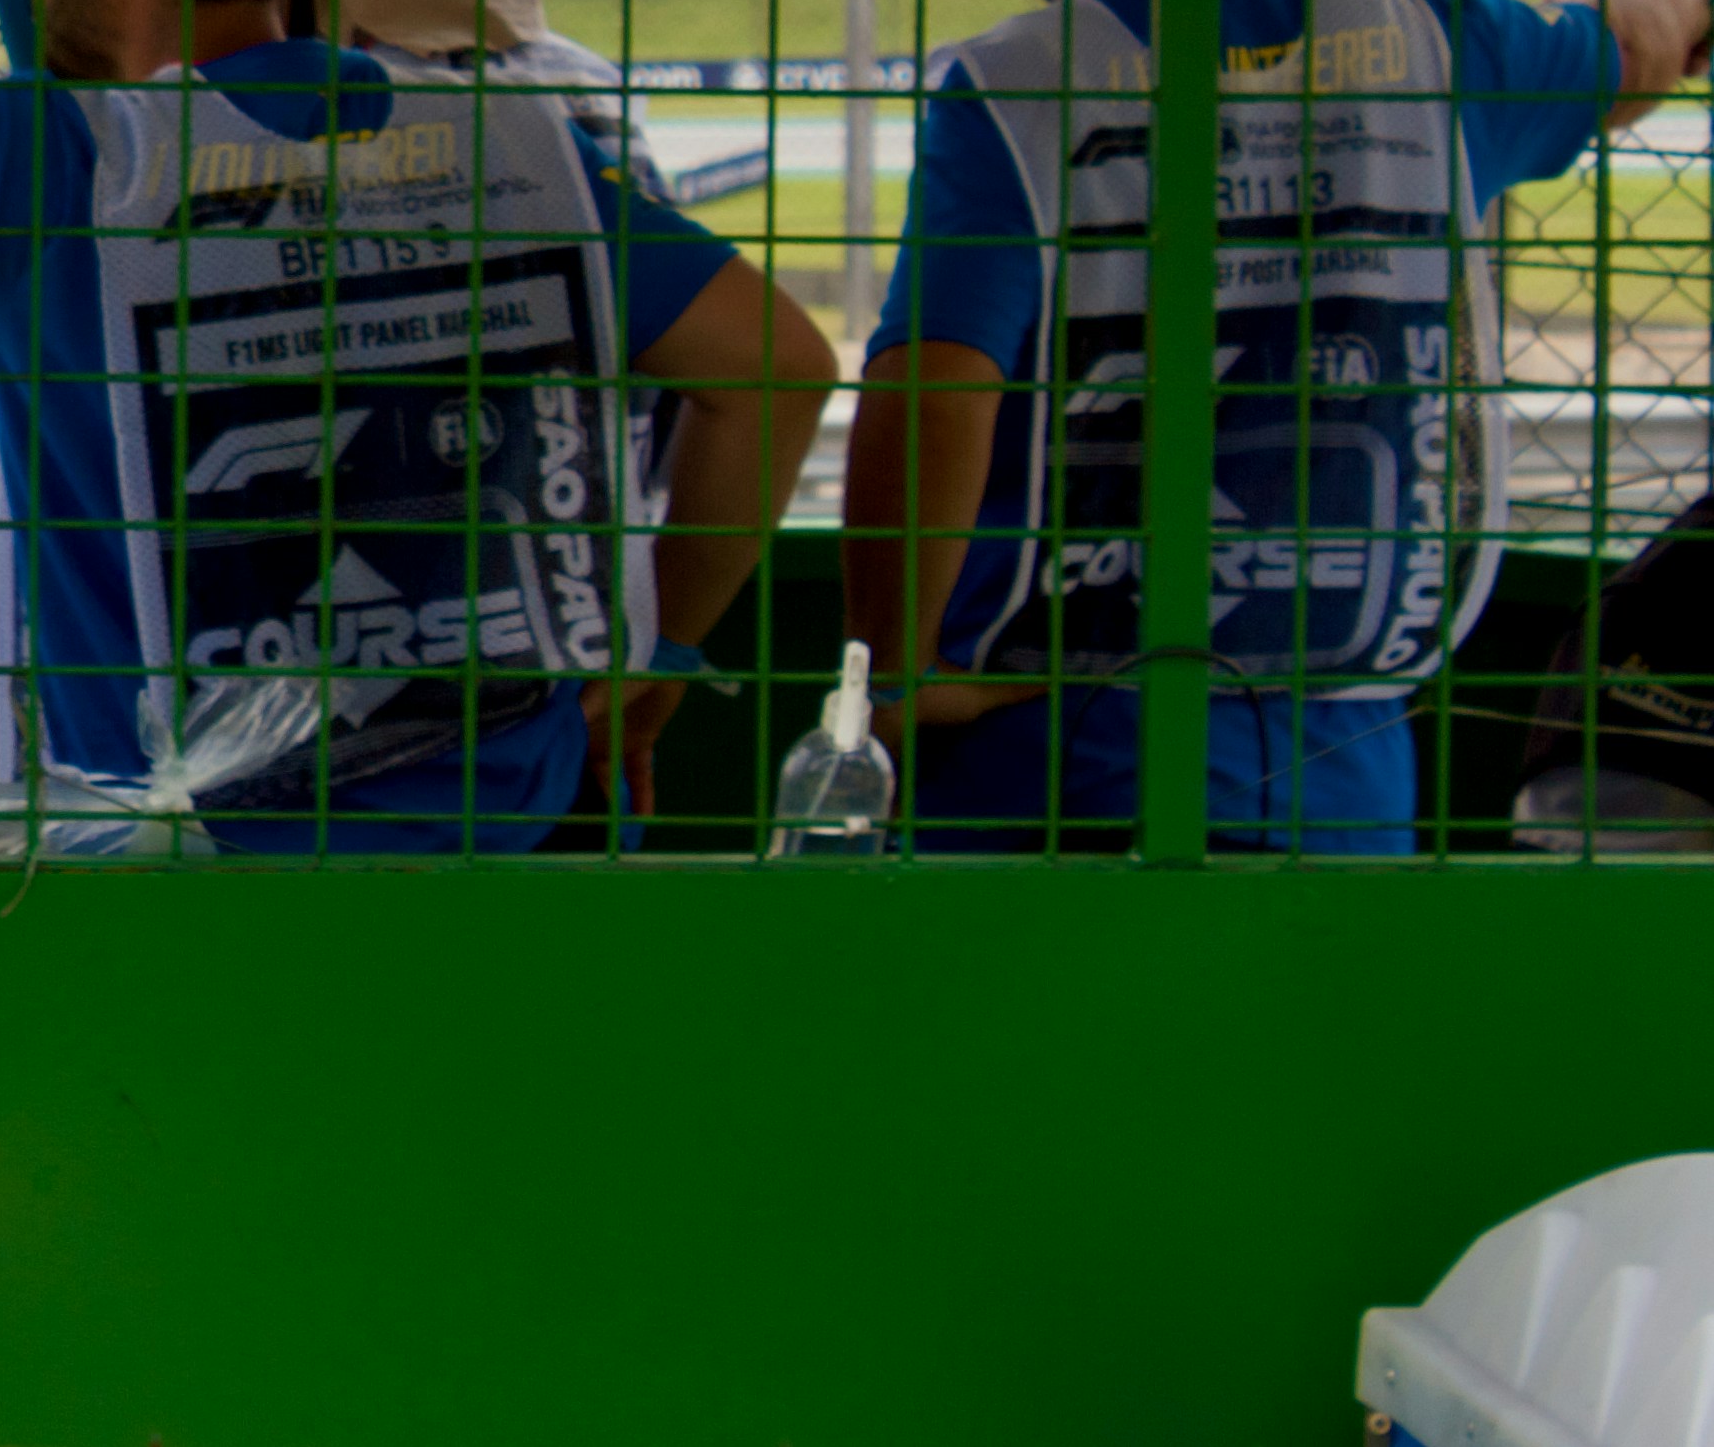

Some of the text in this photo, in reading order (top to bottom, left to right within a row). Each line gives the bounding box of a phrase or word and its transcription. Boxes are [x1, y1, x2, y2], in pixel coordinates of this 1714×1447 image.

[293, 322, 352, 357] LIGT
[359, 312, 433, 349] PANEL
[1041, 527, 1368, 597] CORSE
[186, 588, 534, 671] COURSE
